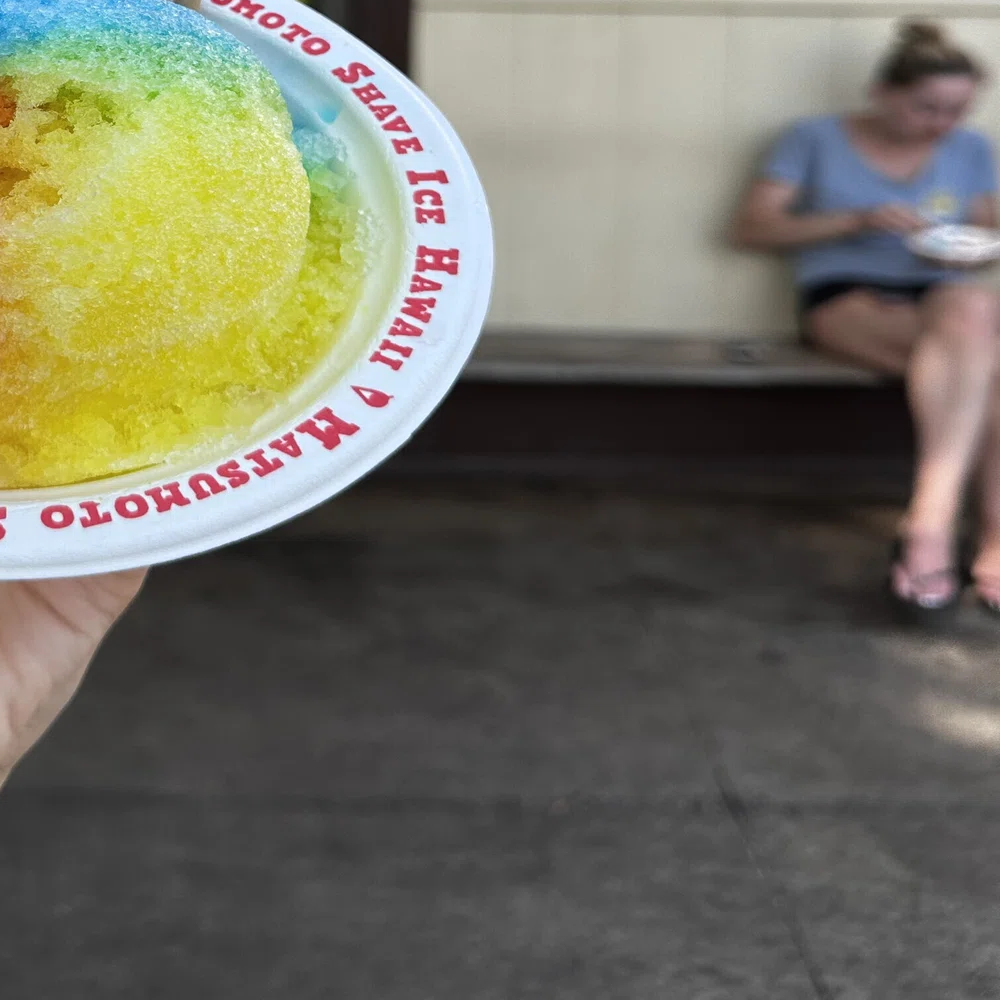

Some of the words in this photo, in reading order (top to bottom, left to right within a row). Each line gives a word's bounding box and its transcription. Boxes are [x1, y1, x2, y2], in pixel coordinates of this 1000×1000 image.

[332, 61, 424, 155] SHAVE
[406, 169, 449, 225] ICE
[369, 245, 460, 372] HAWAII
[39, 406, 361, 530] MATSUMOTO
